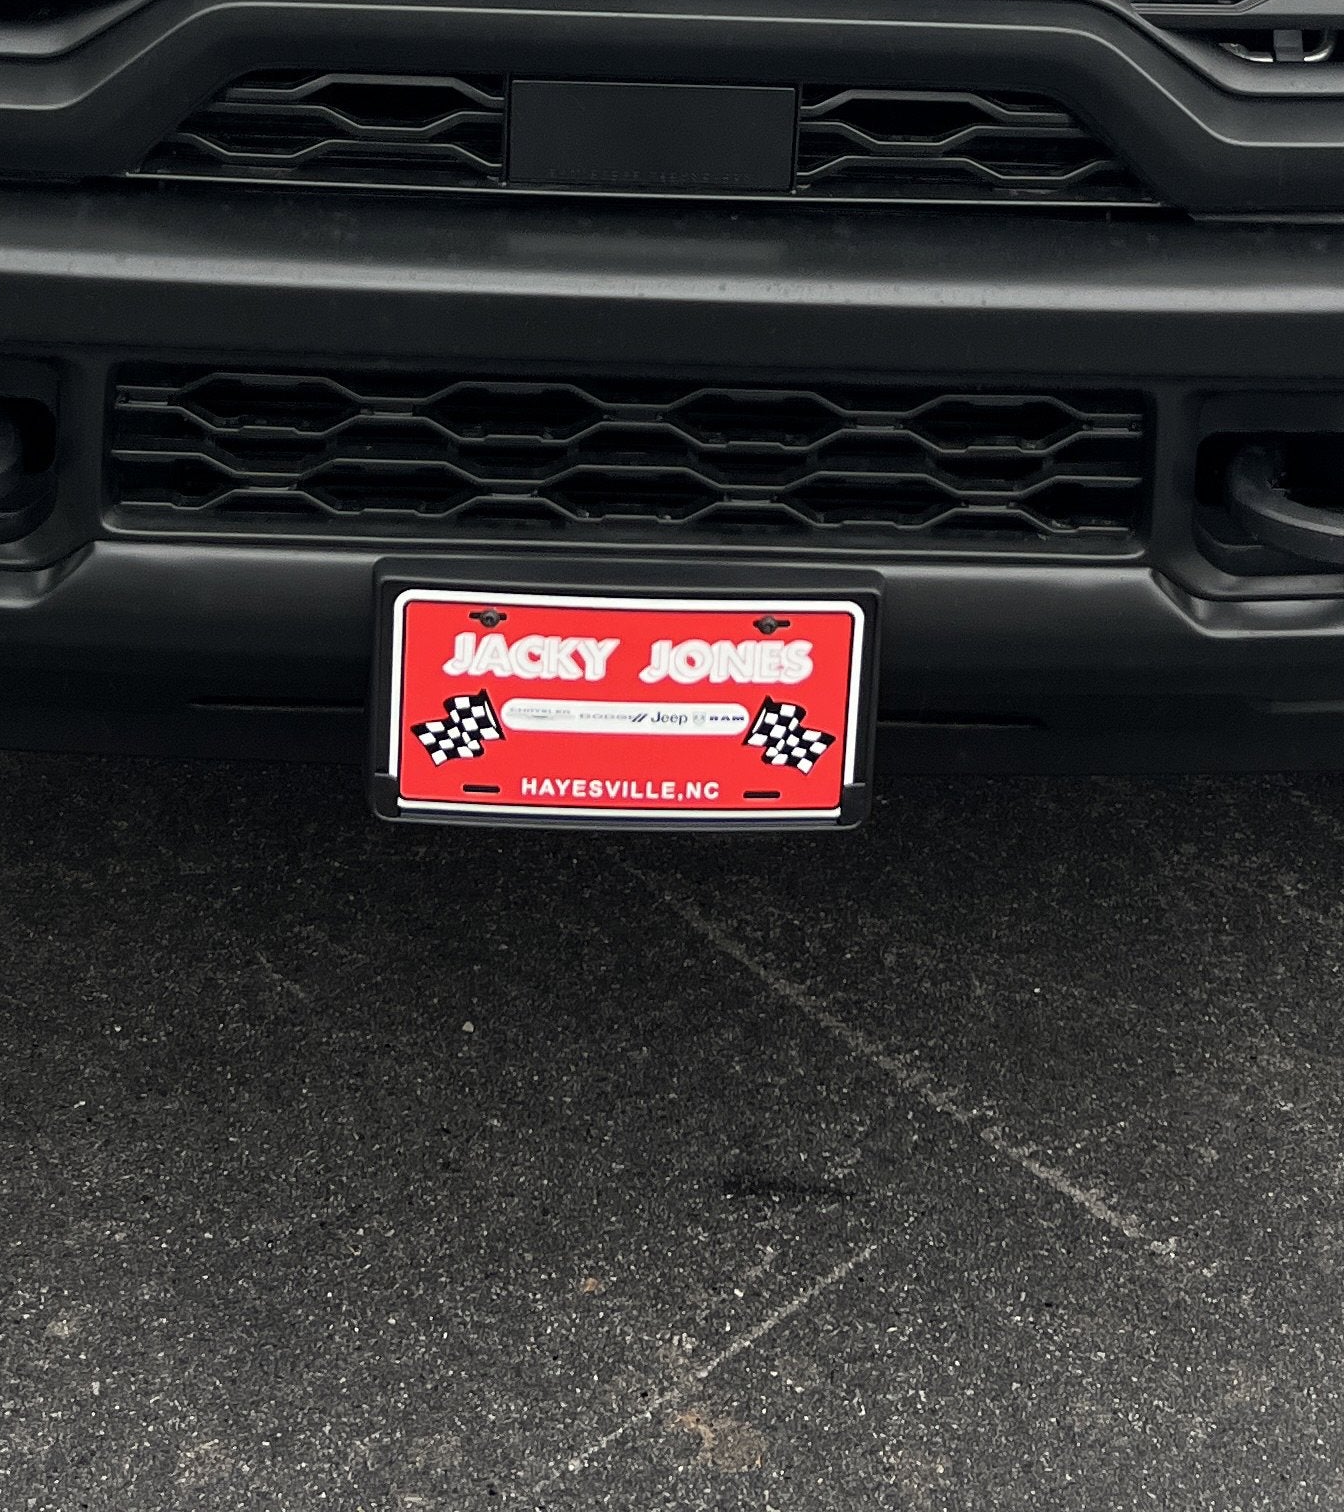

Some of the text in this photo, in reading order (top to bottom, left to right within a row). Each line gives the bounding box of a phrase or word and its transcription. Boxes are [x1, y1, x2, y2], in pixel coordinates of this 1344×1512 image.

[442, 631, 814, 685] JACKY JONES
[650, 711, 688, 726] Jeep
[520, 776, 721, 802] HAYESVILLE,NC
